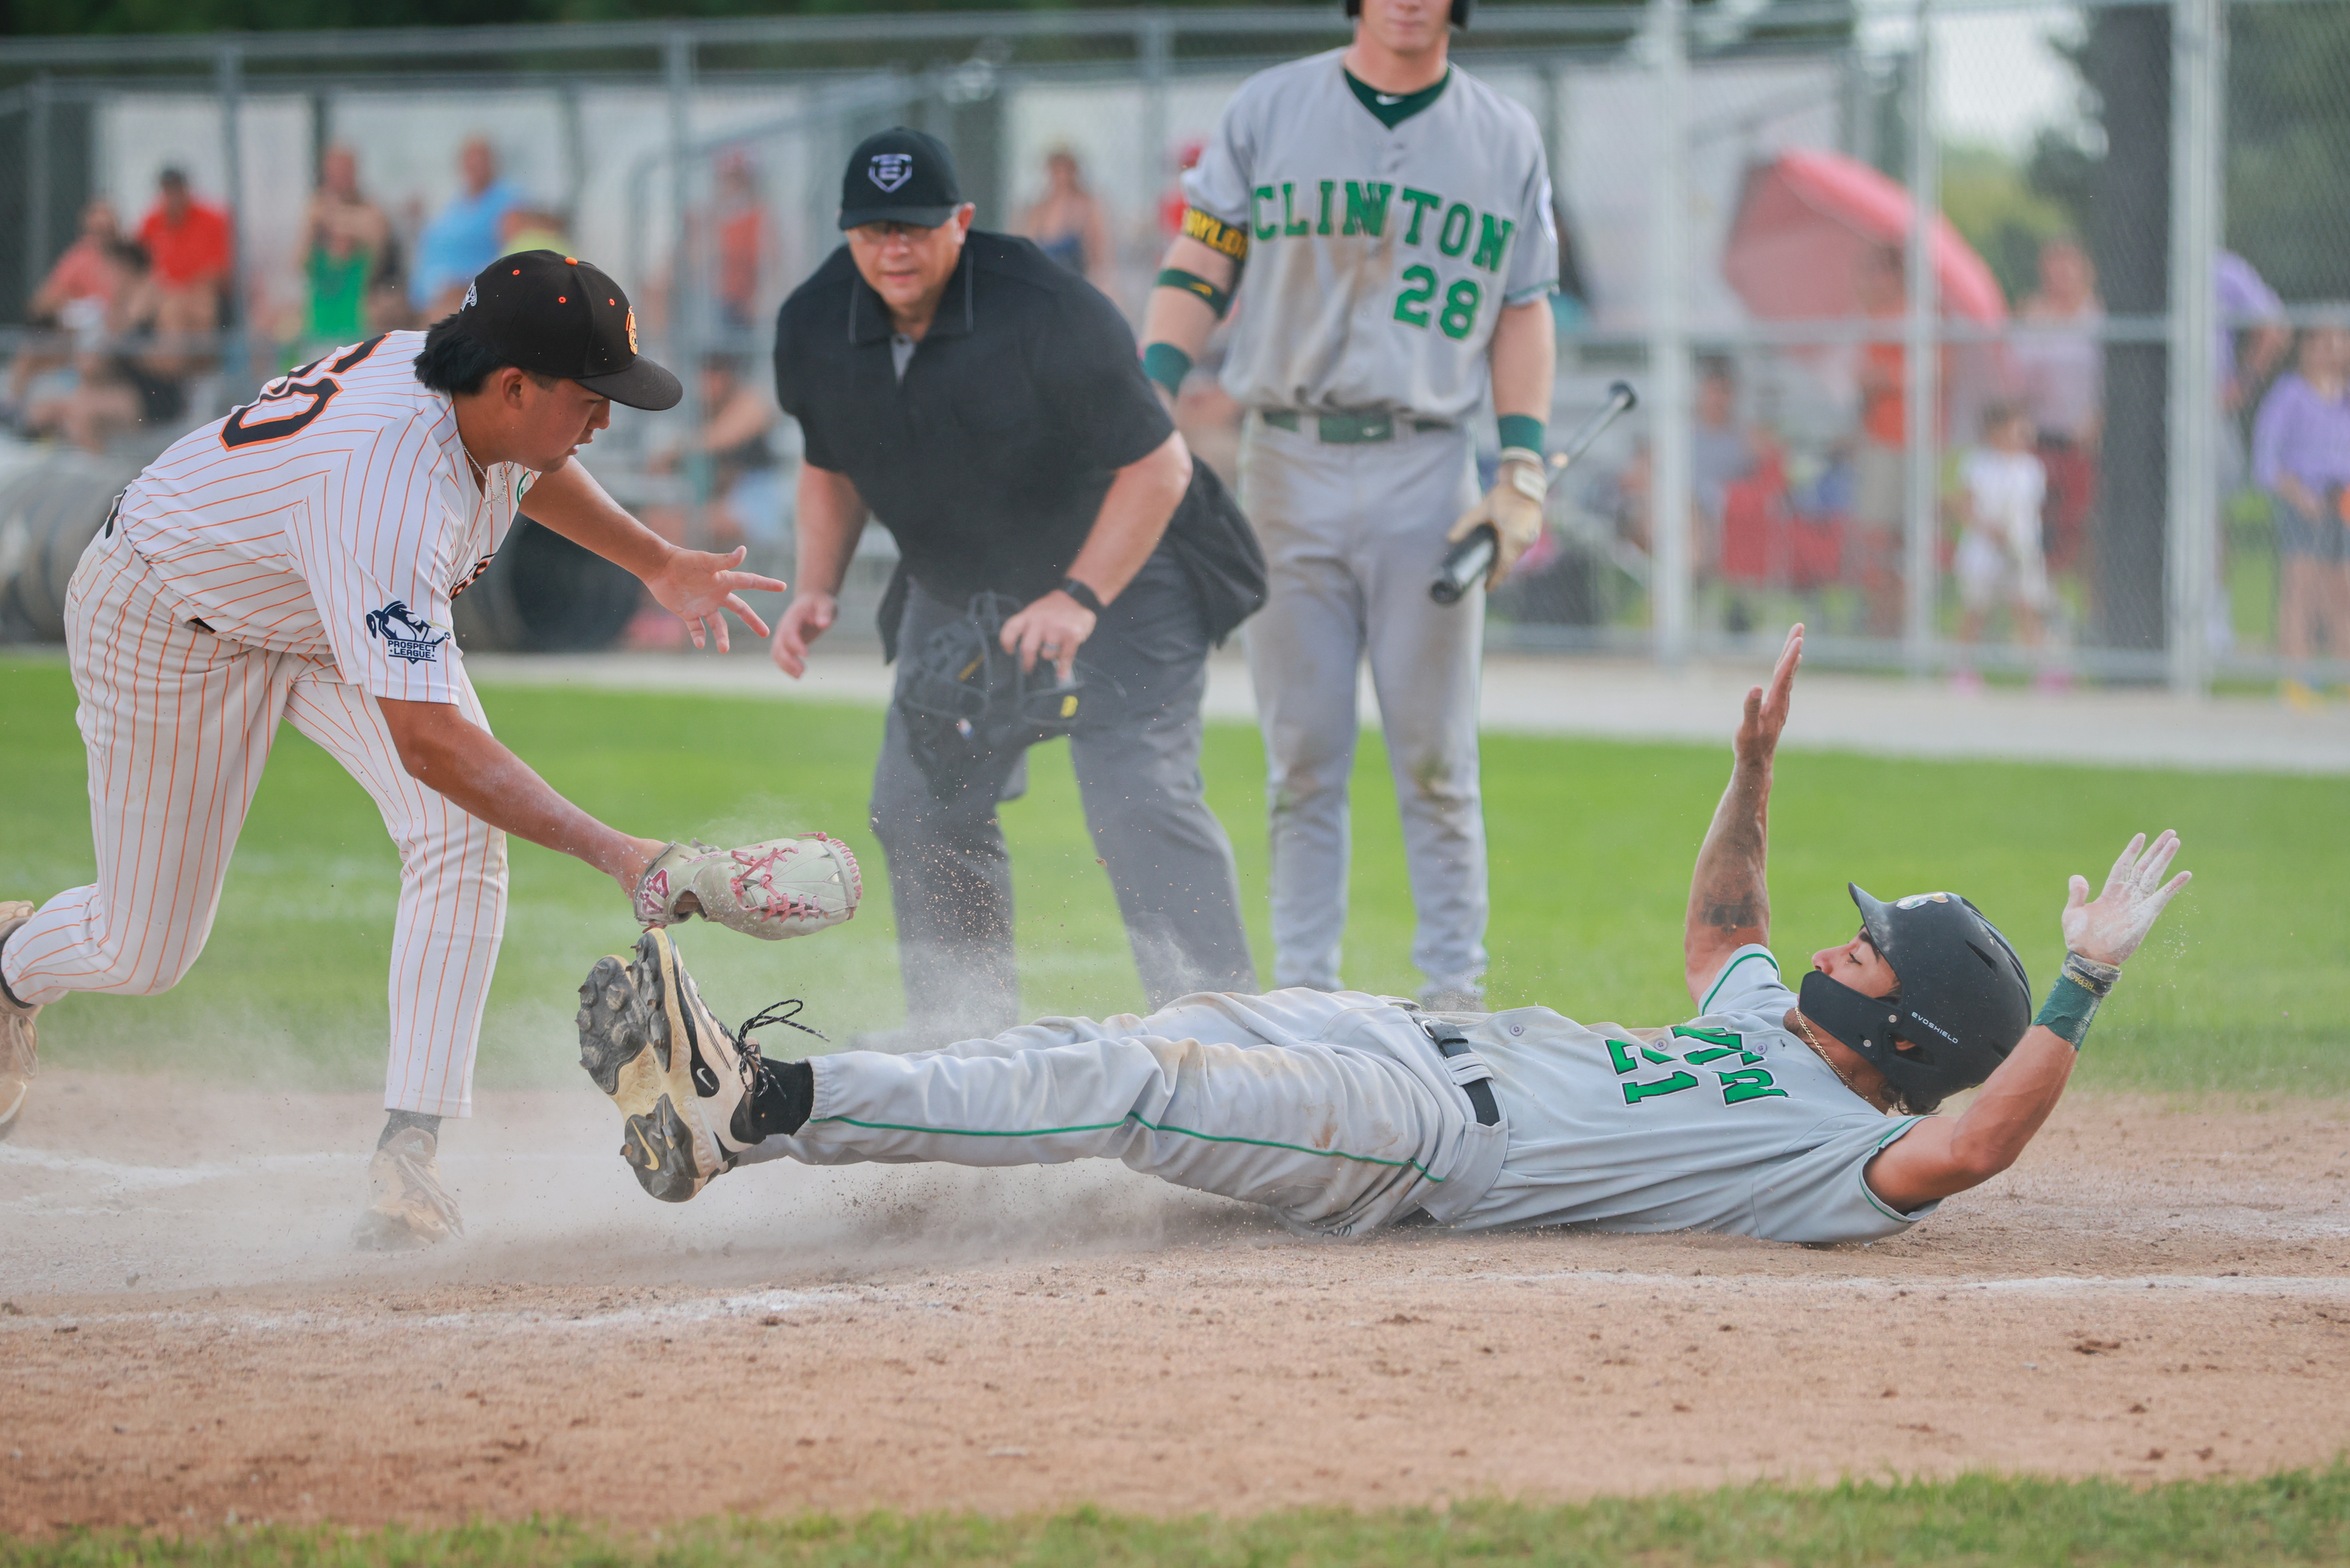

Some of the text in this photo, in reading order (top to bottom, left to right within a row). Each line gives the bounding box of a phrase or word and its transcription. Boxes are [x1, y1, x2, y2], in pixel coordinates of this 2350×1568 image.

[1253, 178, 1516, 274] CLINTON
[1392, 263, 1481, 341] 28
[387, 640, 437, 653] PROSPECT
[393, 648, 432, 659] LEAGUE
[1911, 1011, 1959, 1044] EVOSHIELD
